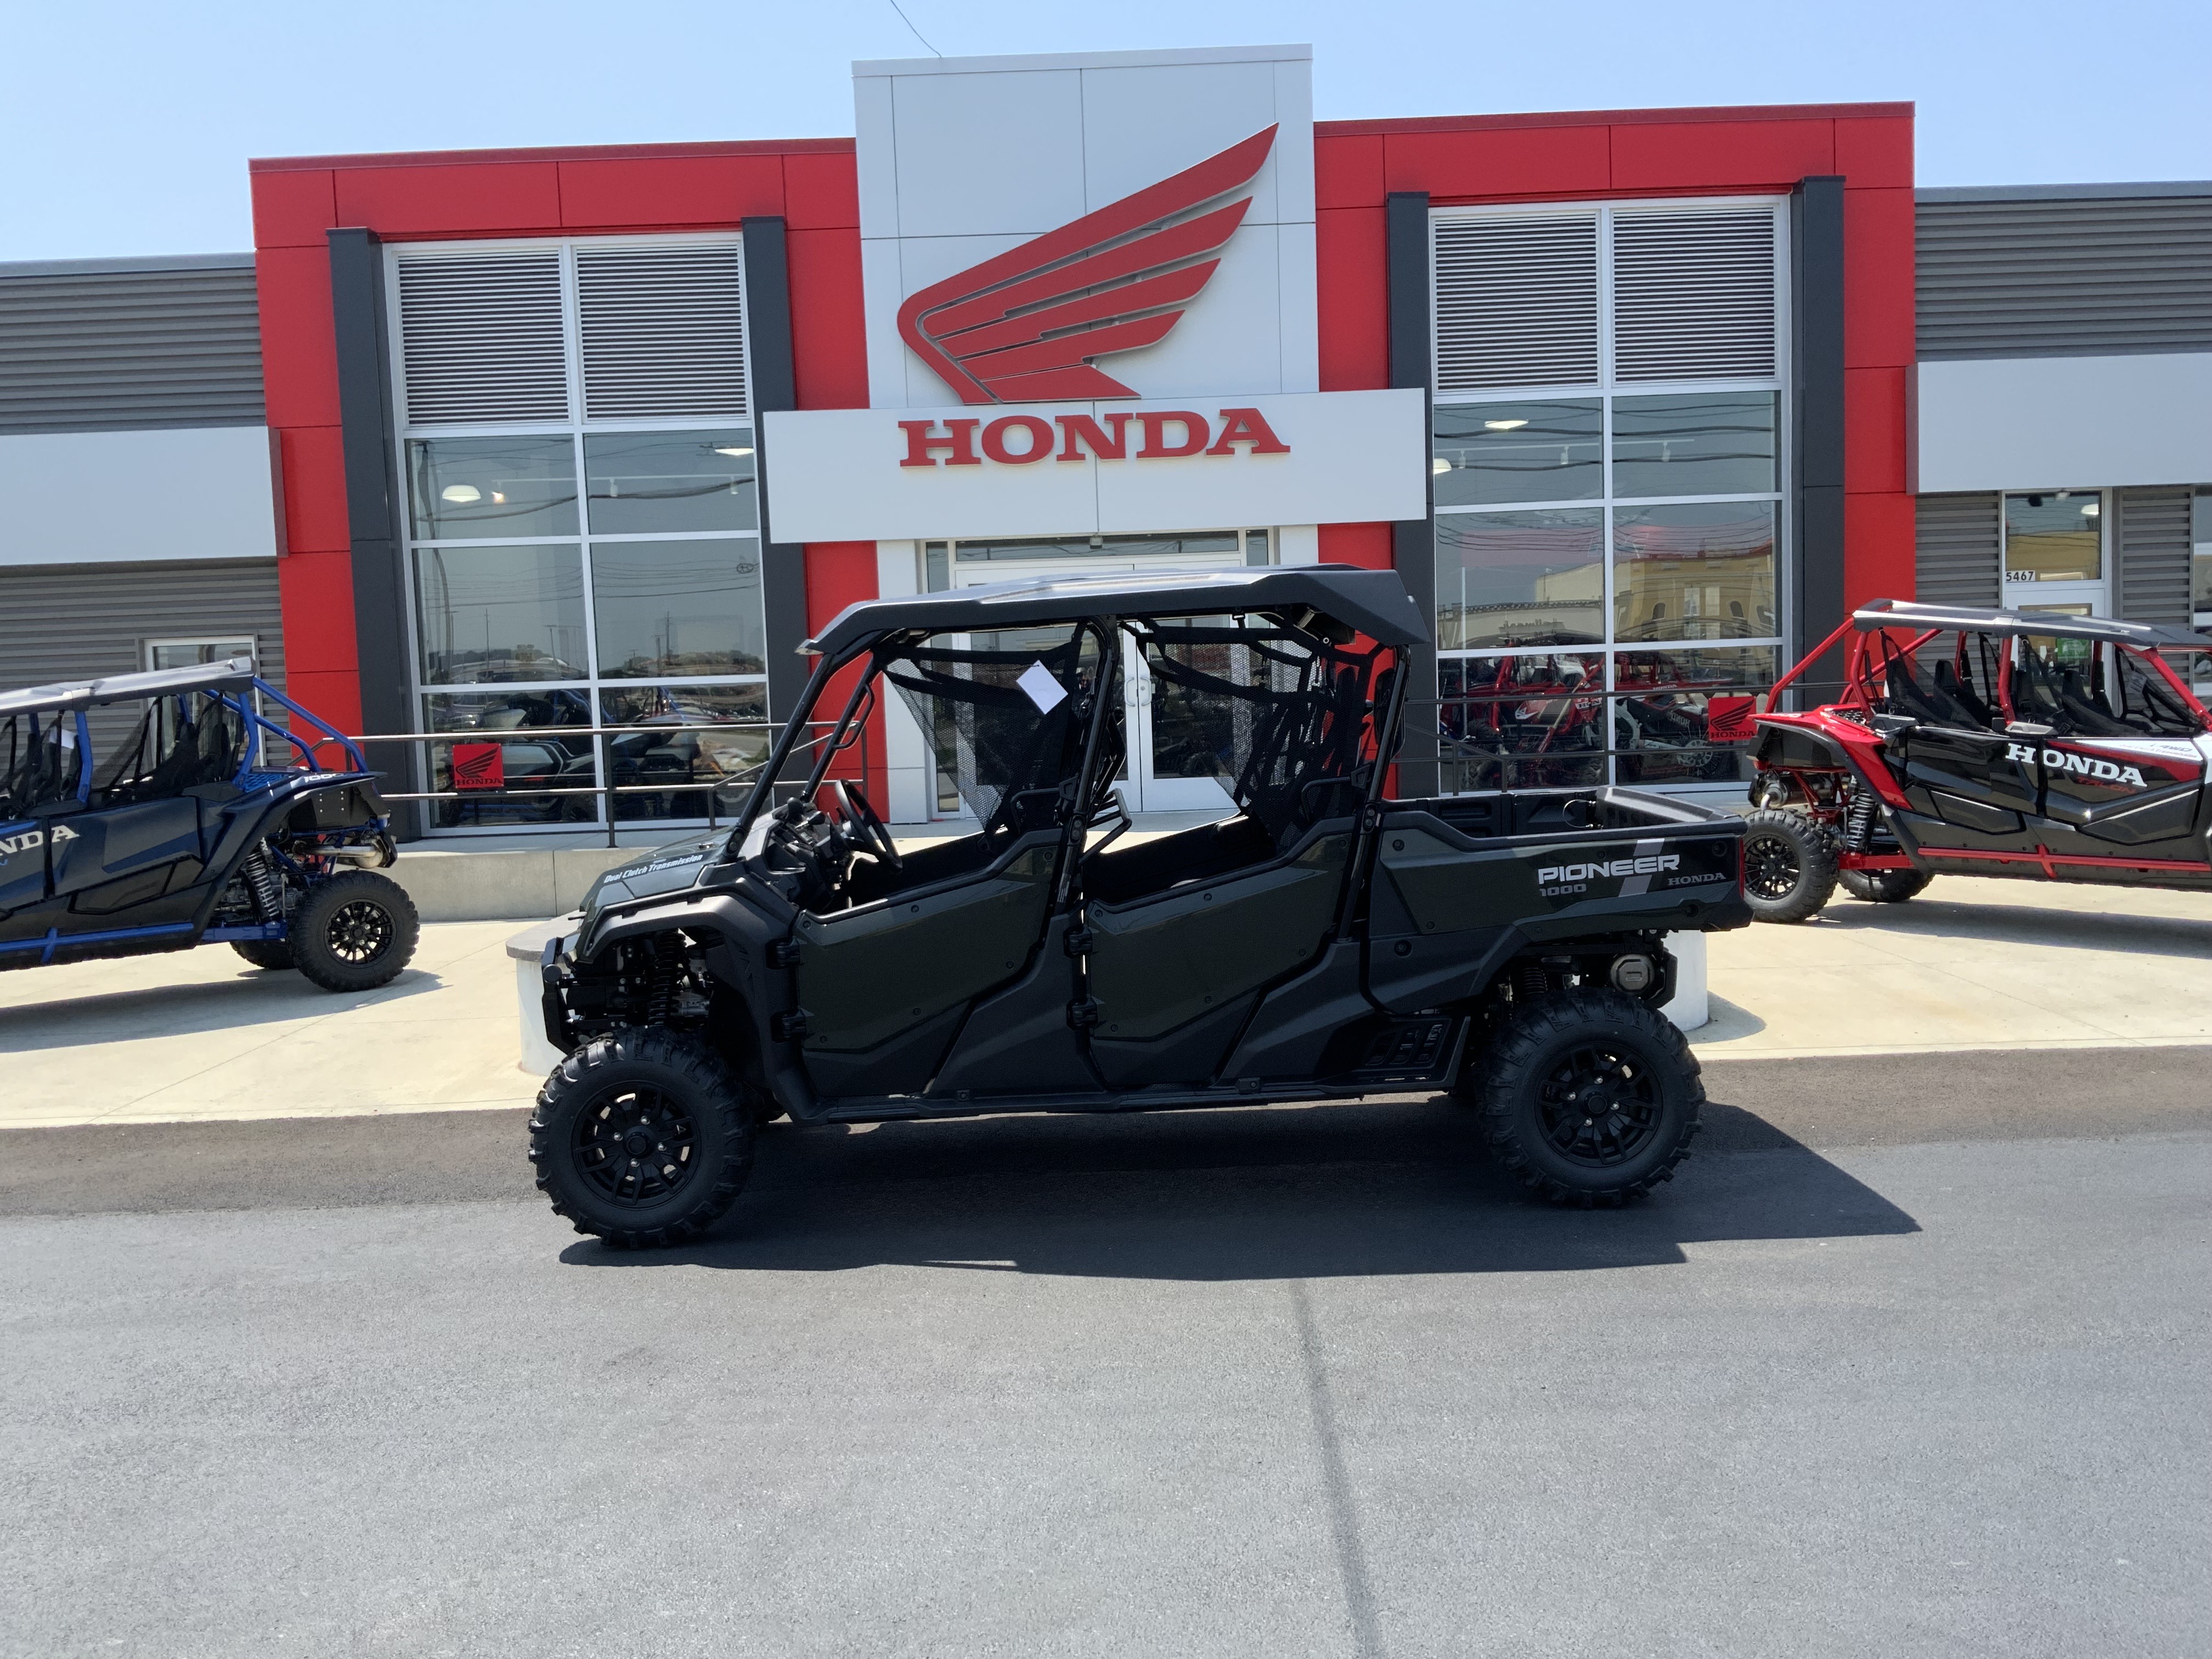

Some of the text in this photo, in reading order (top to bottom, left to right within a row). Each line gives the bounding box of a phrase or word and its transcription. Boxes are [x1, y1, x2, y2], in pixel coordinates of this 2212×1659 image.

[898, 408, 1290, 466] HONDA
[2006, 571, 2034, 582] 5467
[2155, 748, 2198, 758] Transmission
[2005, 742, 2148, 788] HONDA
[456, 777, 503, 786] HONDA
[0, 825, 80, 856] NDA
[604, 854, 703, 883] Dual Clutch Transmission
[1538, 854, 1680, 884] PIONEER
[1668, 872, 1726, 885] HONDA
[1539, 883, 1587, 896] 1000
